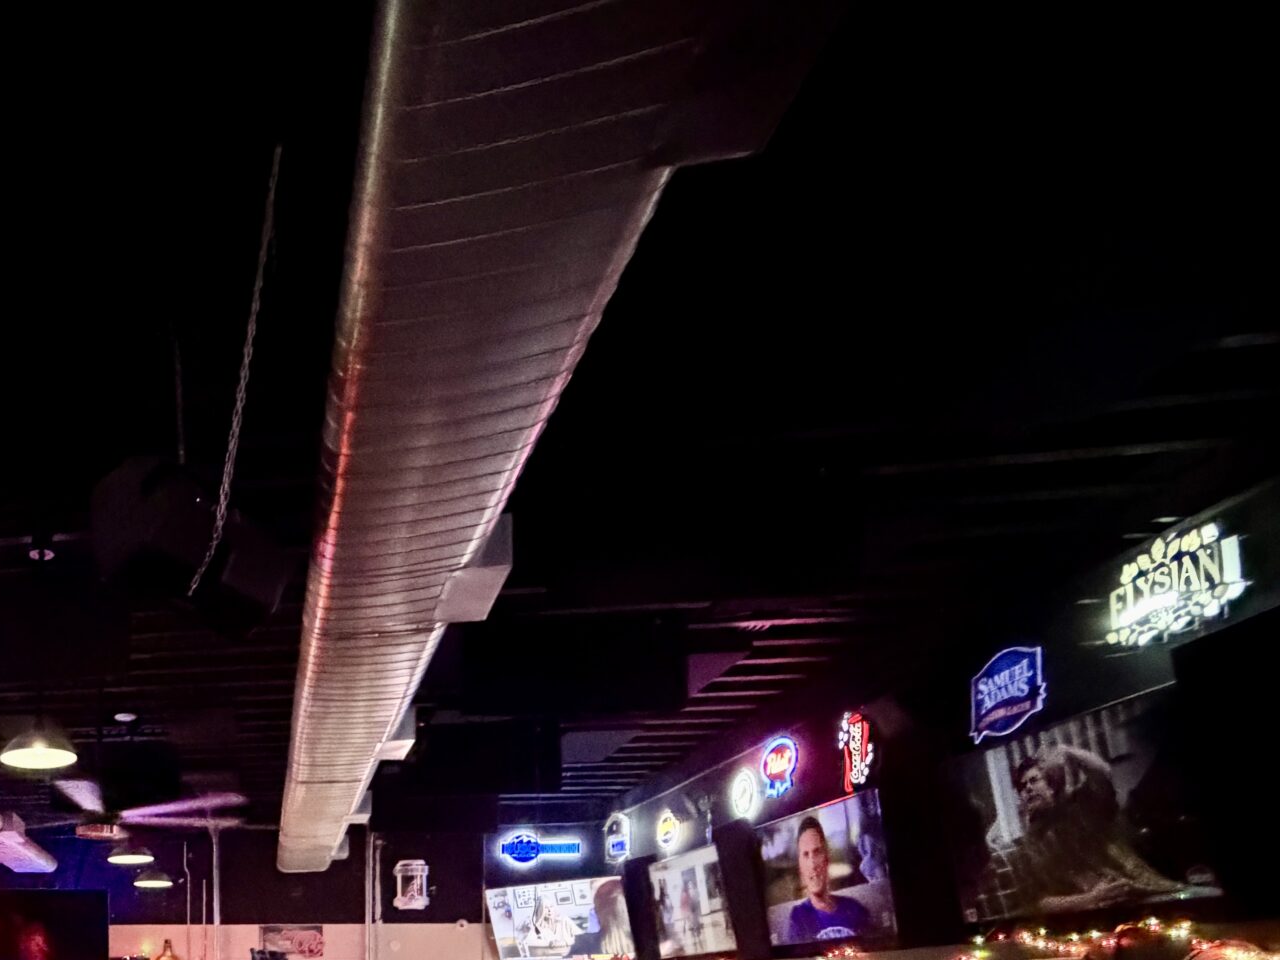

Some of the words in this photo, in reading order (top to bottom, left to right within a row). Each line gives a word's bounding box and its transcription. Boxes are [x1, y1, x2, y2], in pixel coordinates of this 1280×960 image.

[1109, 541, 1221, 631] ELYSIAN
[977, 658, 1033, 700] SAMUEL
[981, 677, 1029, 715] ADAMS
